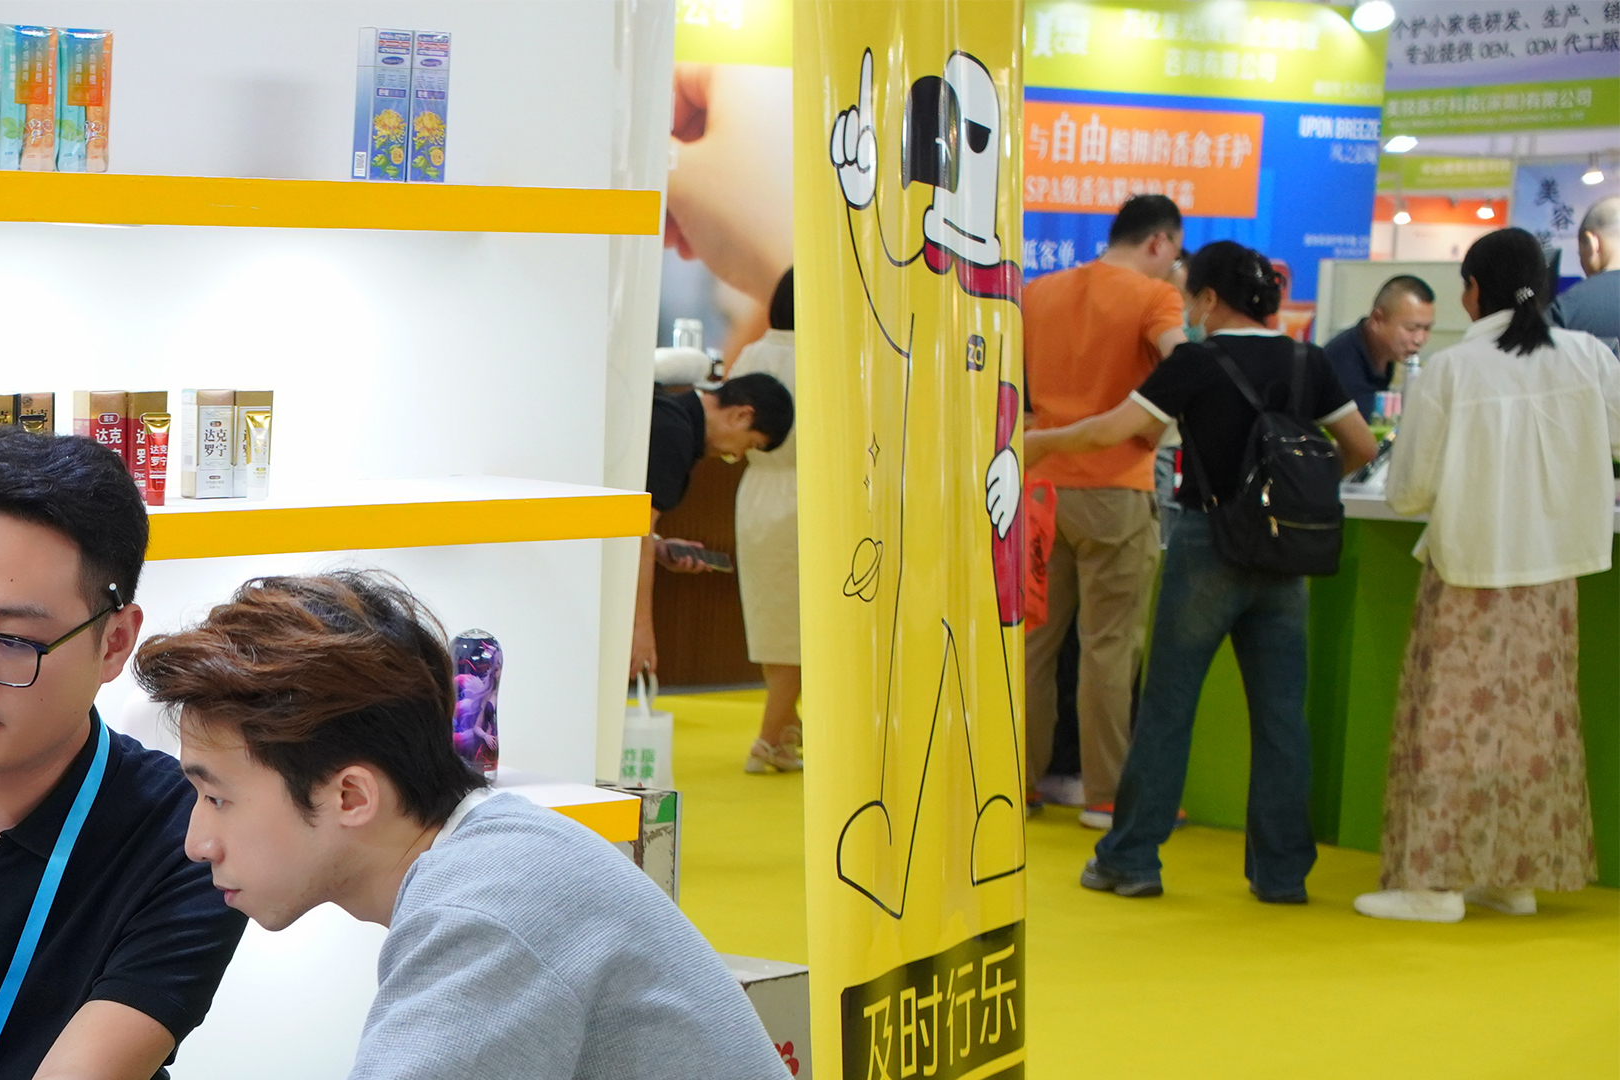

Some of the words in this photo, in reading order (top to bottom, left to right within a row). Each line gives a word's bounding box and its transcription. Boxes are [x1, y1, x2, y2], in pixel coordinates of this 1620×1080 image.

[95, 427, 123, 444] 达克
[204, 429, 228, 442] 达克
[204, 443, 228, 457] 罗宁
